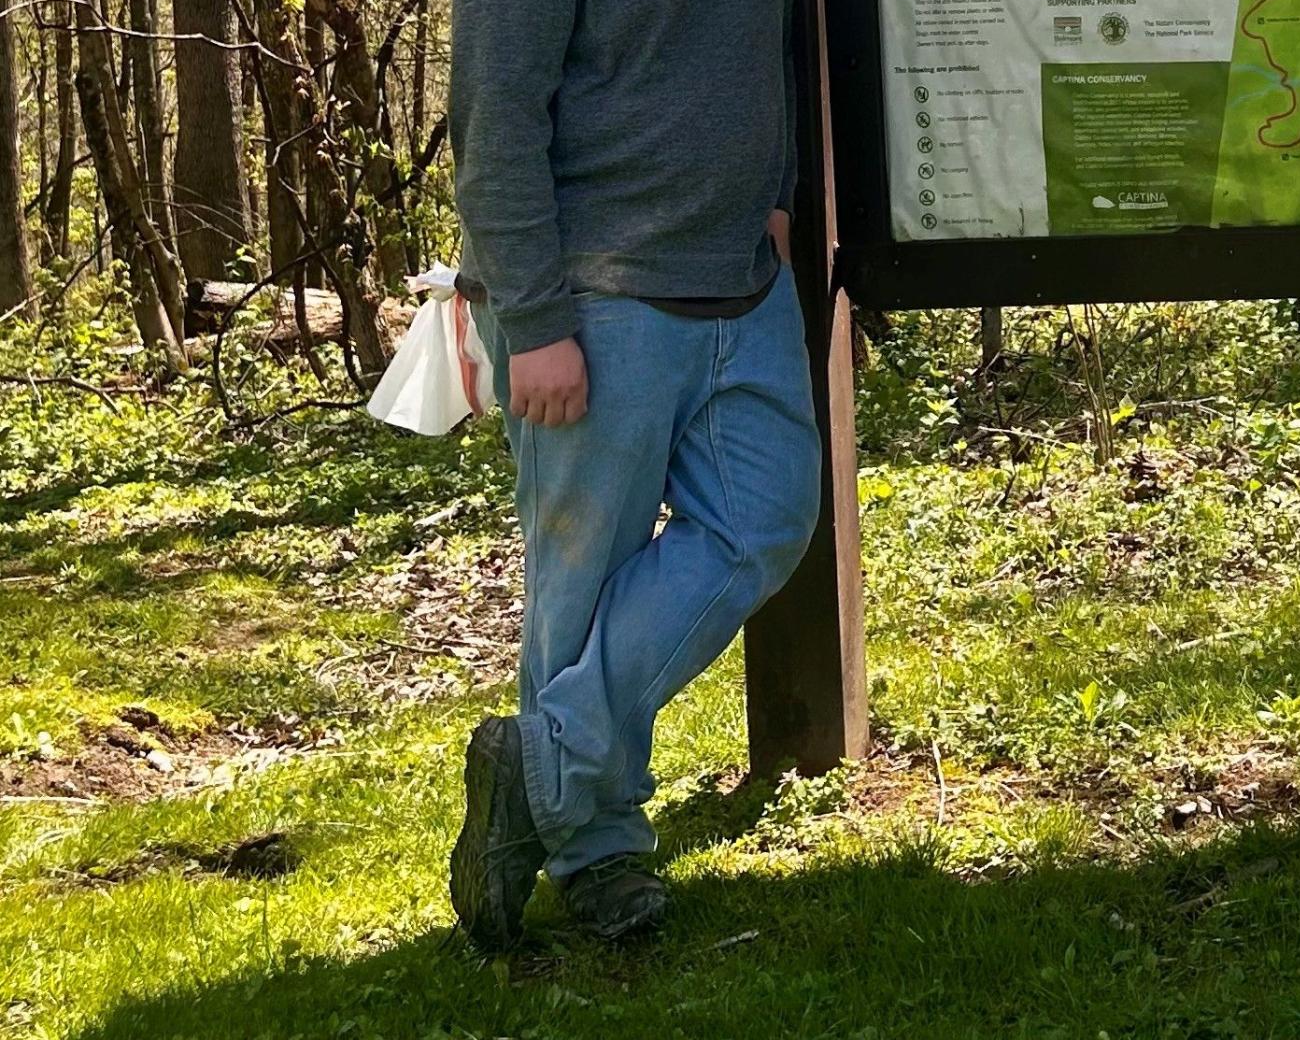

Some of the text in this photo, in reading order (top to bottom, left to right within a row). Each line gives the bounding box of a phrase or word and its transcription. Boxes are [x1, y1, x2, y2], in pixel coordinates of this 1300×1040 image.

[1052, 74, 1147, 84] CAPTINA CONSERVANCY
[1118, 192, 1167, 203] CAPTINA
